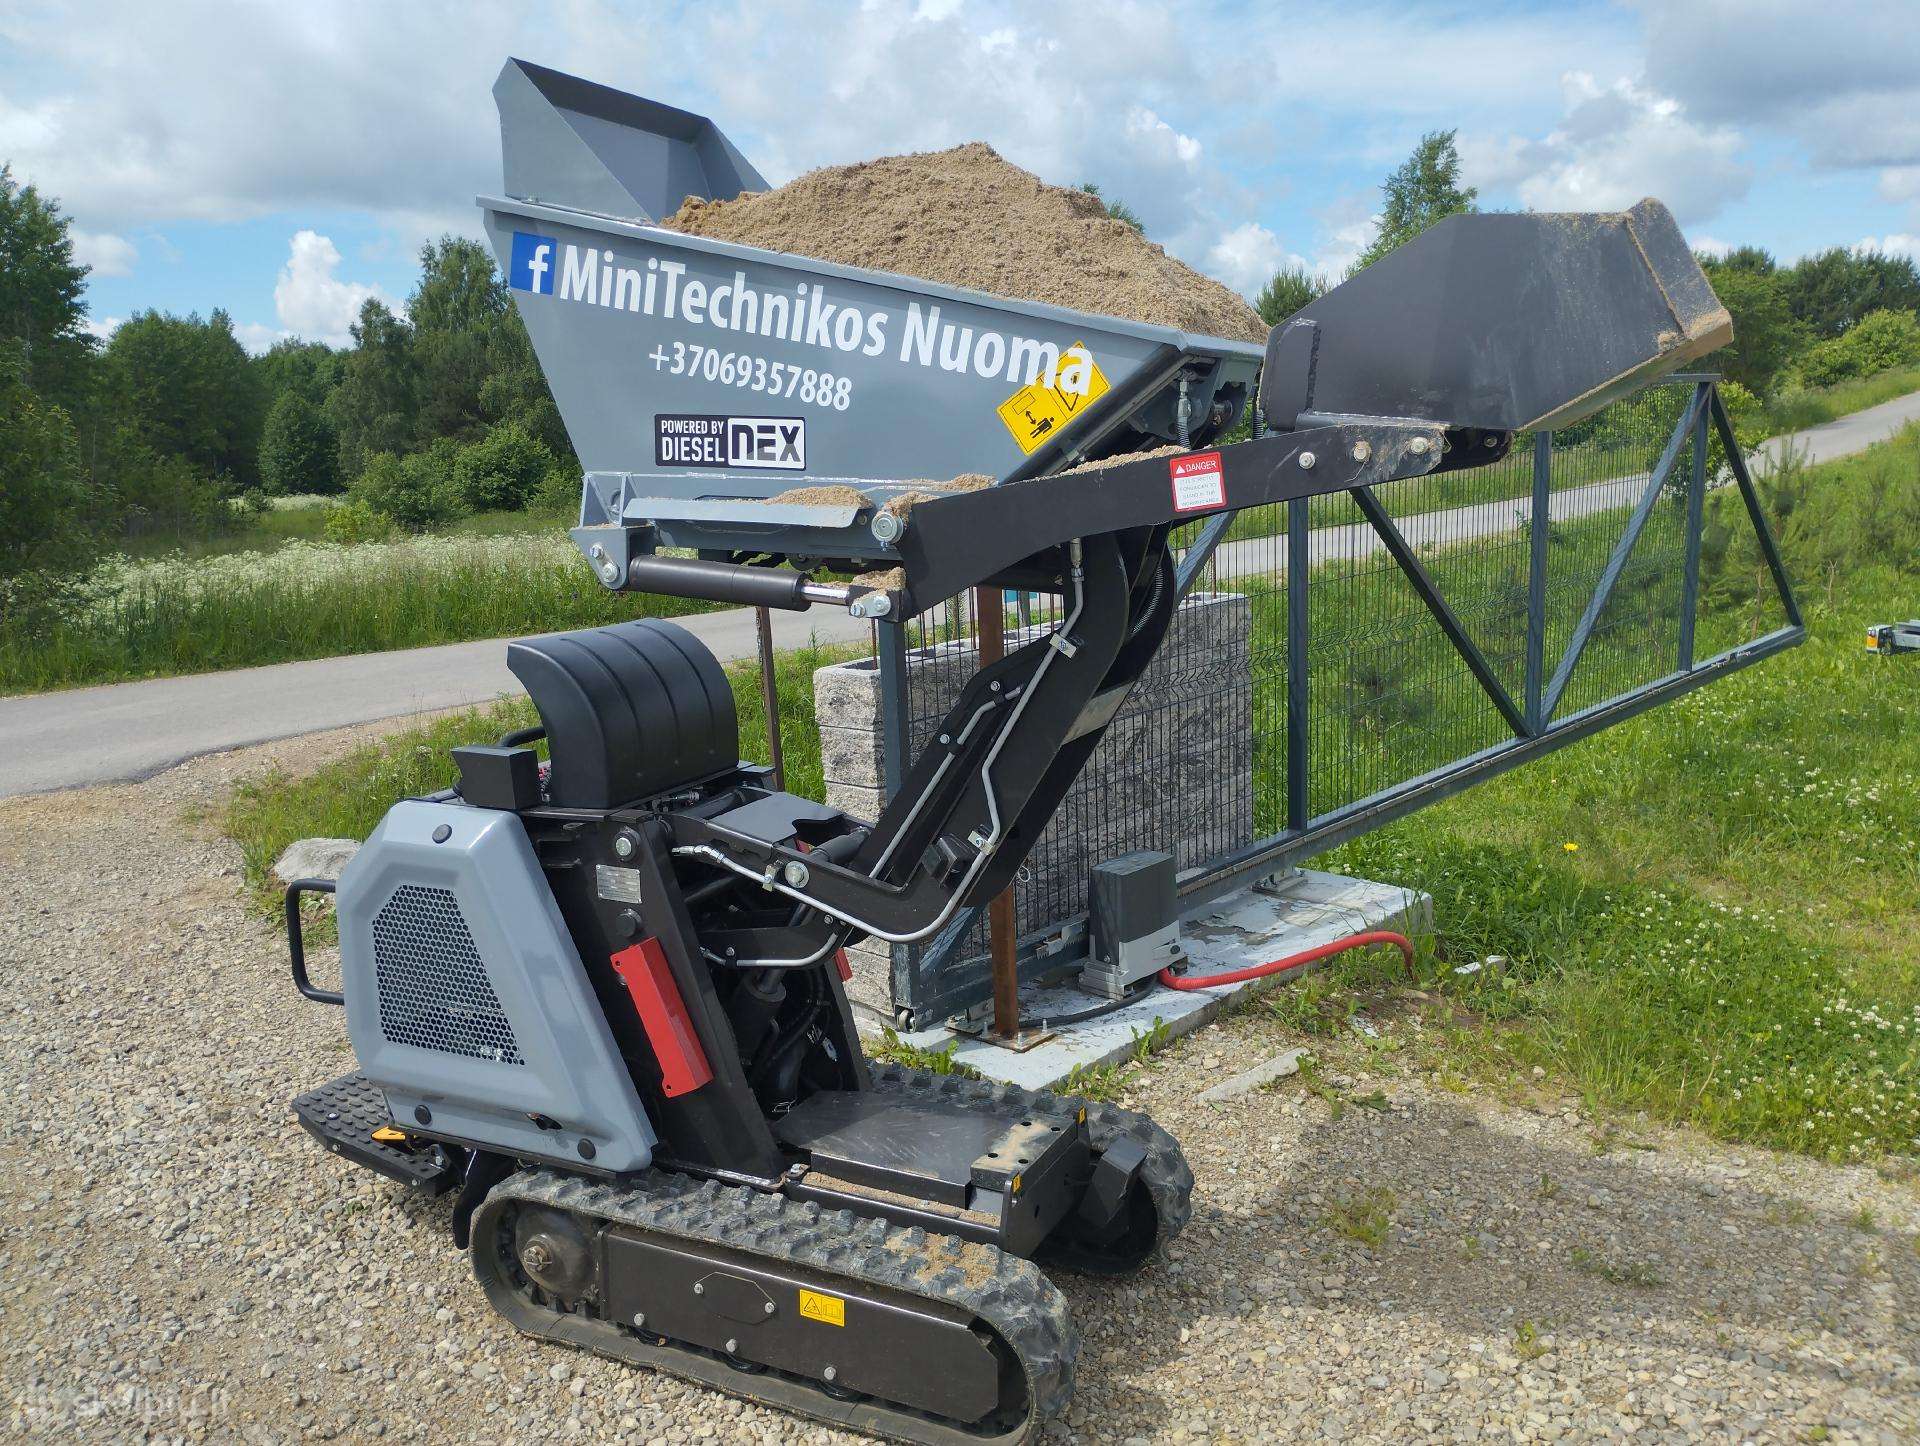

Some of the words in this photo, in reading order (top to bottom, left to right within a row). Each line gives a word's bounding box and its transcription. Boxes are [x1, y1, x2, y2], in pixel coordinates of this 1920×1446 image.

[560, 244, 889, 357] MiniTechnikos
[900, 301, 1092, 396] Nuoma
[649, 342, 853, 412] +37069357888
[661, 420, 708, 434] POWERED
[711, 420, 724, 434] BY
[662, 437, 725, 462] DIESEL
[1186, 460, 1217, 472] DANGER
